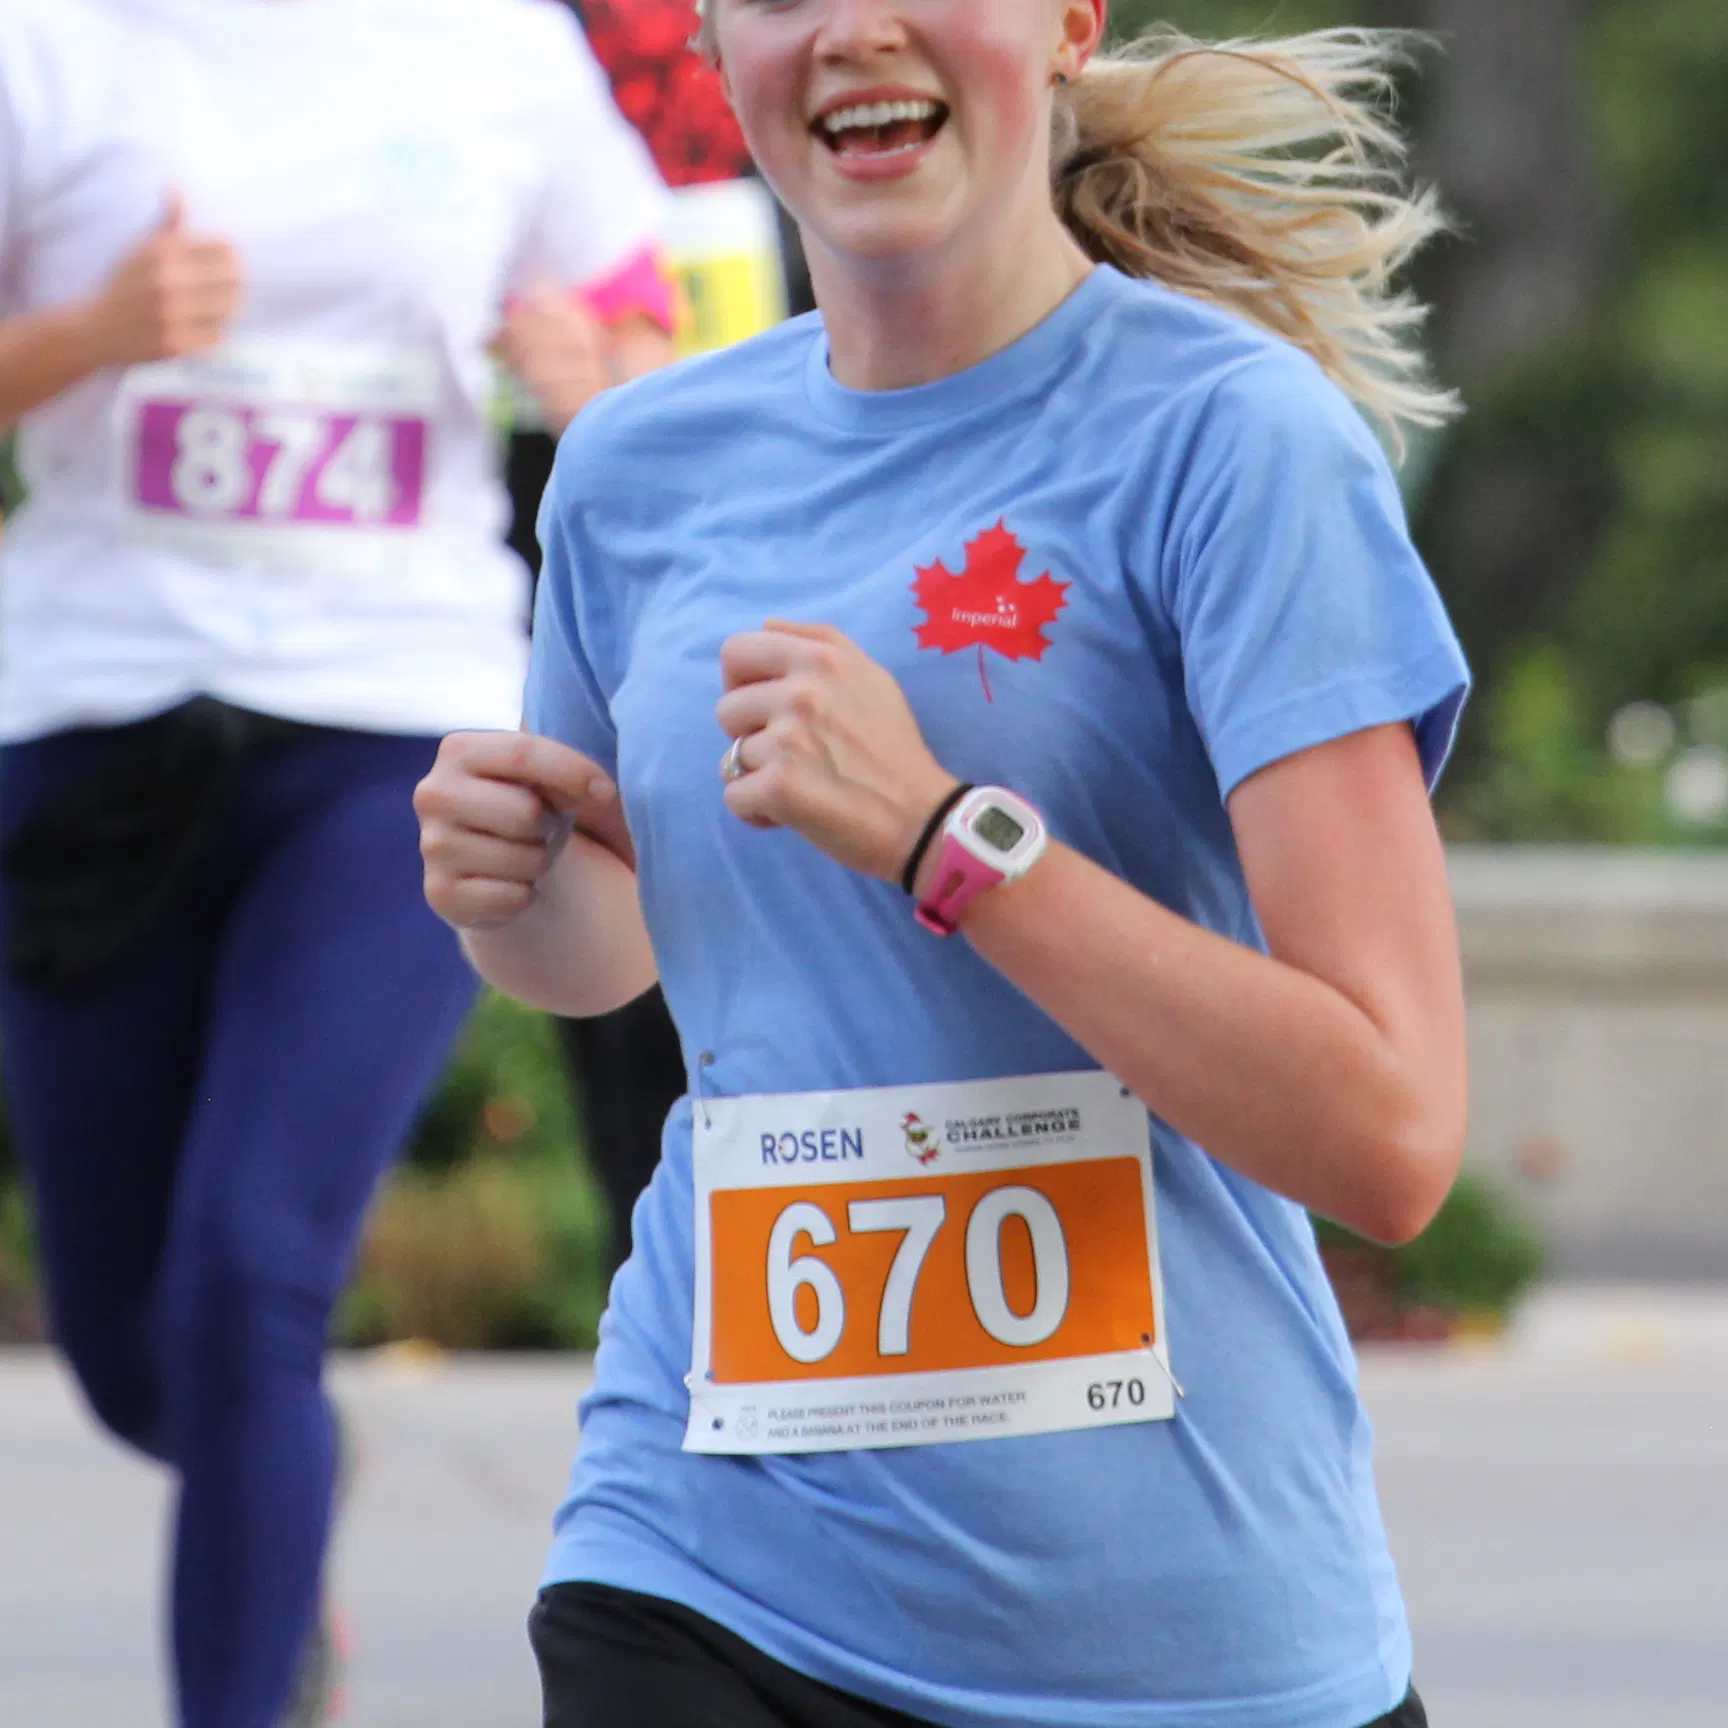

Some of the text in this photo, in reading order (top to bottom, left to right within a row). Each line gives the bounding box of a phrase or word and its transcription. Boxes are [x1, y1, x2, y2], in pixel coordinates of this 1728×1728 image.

[174, 406, 391, 521] 874
[951, 607, 1017, 628] Imperial
[760, 1127, 864, 1165] ROSEN
[947, 1121, 1080, 1143] CHALLENGE
[766, 1184, 1069, 1364] 670
[767, 1407, 805, 1420] PLEASE
[807, 1405, 855, 1418] PRESENT
[859, 1402, 886, 1415] THIS
[889, 1399, 945, 1412] COUPON
[948, 1395, 975, 1409] FOR
[980, 1392, 1026, 1405] WATER
[1087, 1379, 1146, 1411] 670
[801, 1424, 842, 1437] BANANA
[846, 1423, 861, 1435] AT
[865, 1421, 890, 1433] THE
[891, 1418, 918, 1431] END
[922, 1416, 938, 1429] OF
[943, 1414, 969, 1427] THE
